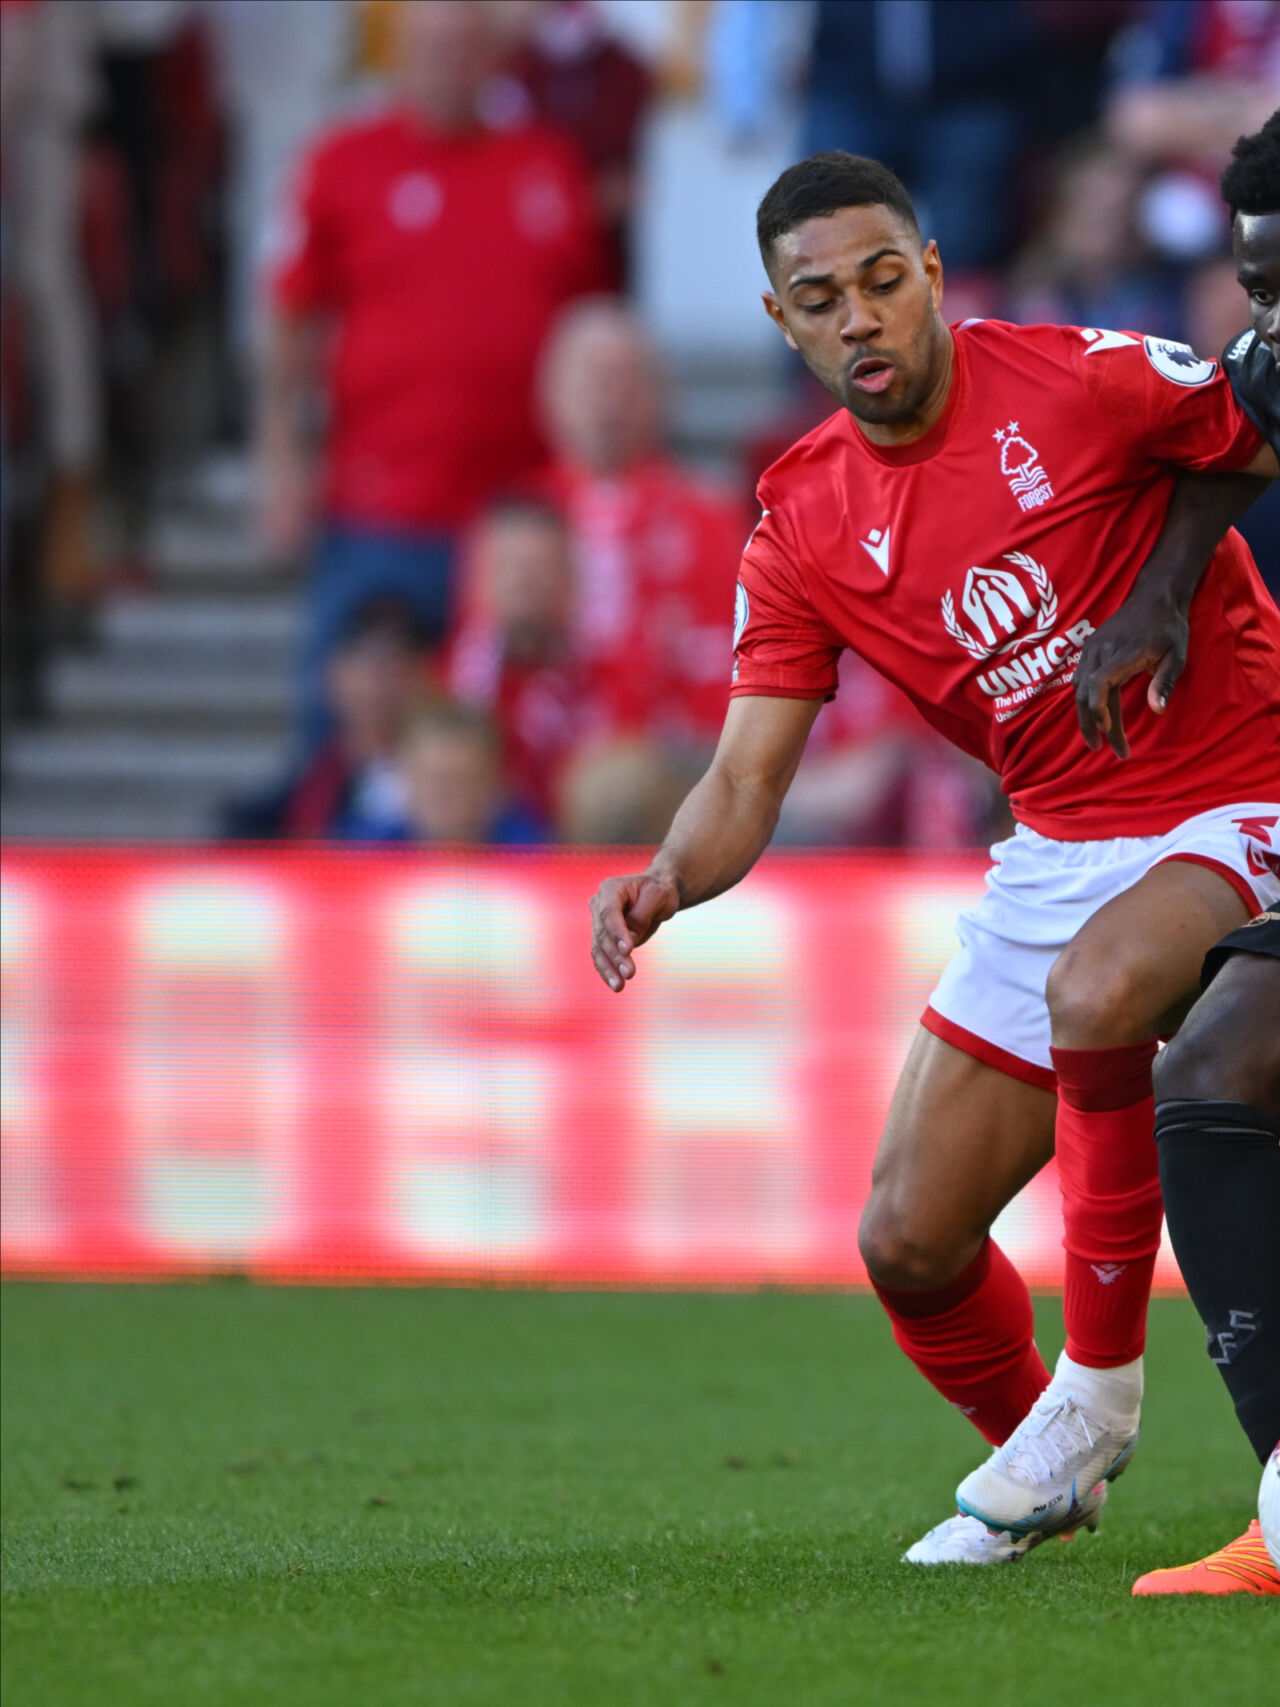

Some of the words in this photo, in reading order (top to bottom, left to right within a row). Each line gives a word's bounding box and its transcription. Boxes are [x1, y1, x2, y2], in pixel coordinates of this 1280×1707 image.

[1017, 481, 1055, 512] FOREST
[976, 618, 1096, 696] UNHCR
[994, 697, 1012, 709] The
[1012, 689, 1027, 703] UN
